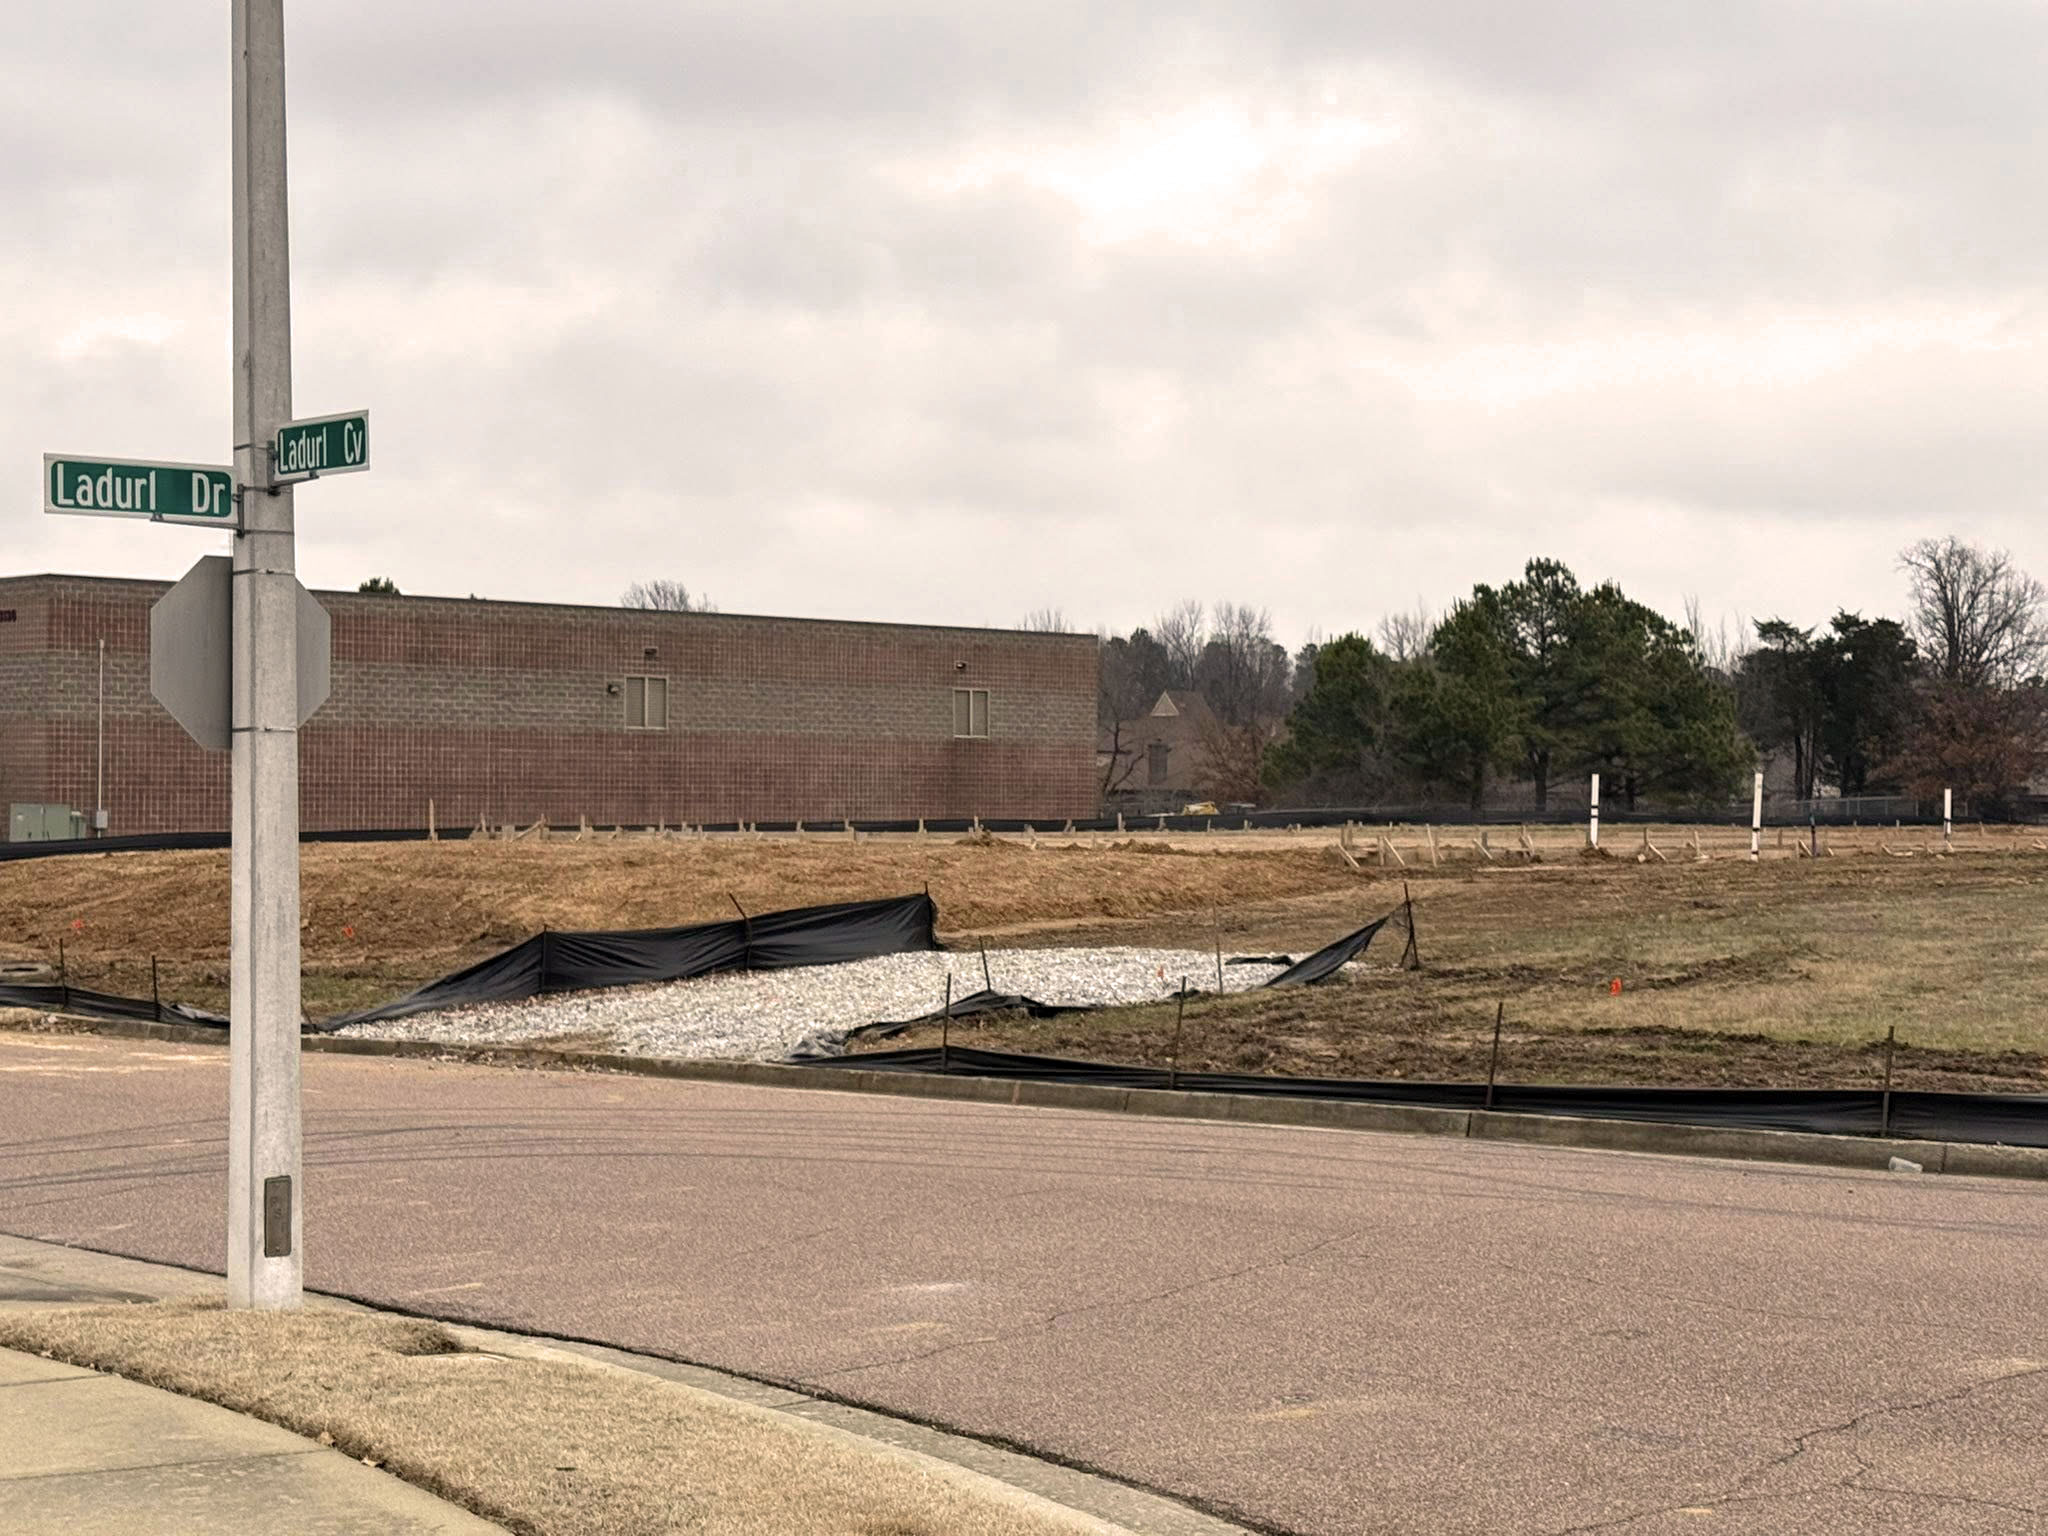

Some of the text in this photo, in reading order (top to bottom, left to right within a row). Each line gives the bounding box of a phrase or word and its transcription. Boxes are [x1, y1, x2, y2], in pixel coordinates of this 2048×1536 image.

[279, 421, 364, 472] Ladurl Cv
[57, 462, 225, 513] Ladurl Dr
